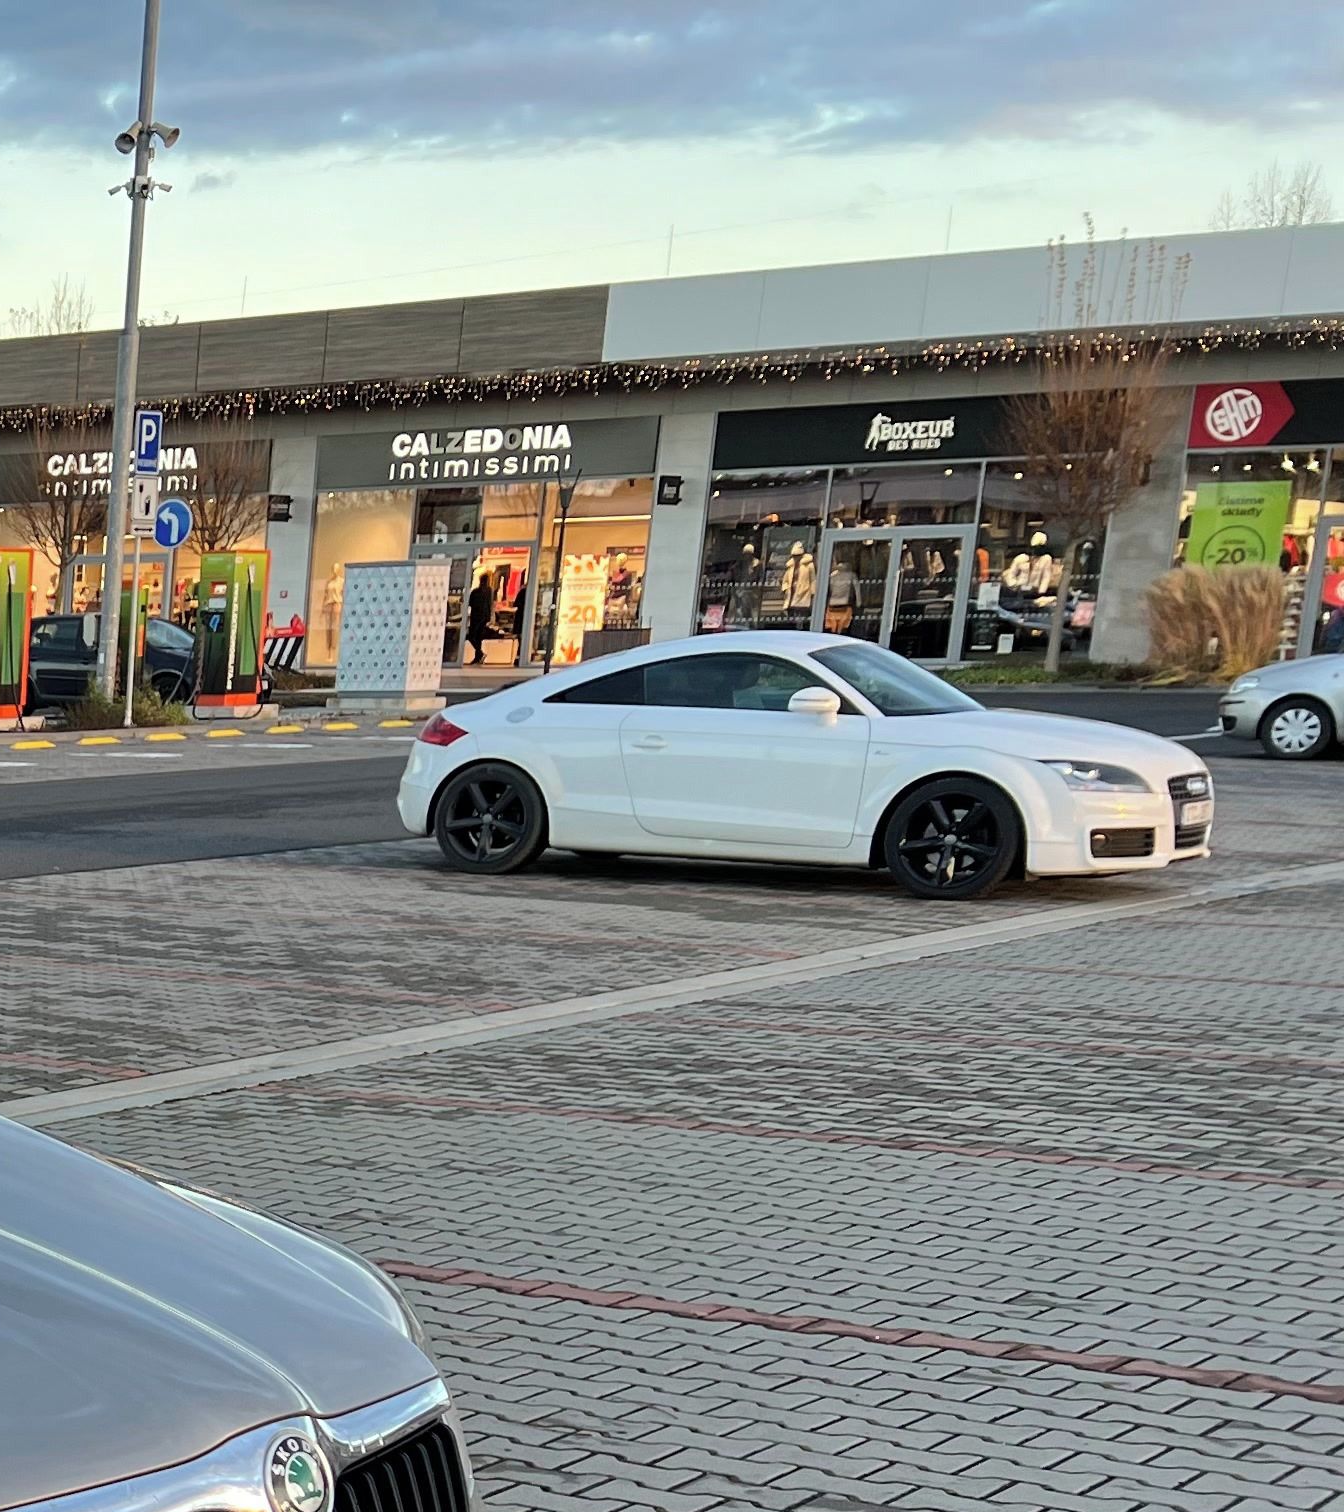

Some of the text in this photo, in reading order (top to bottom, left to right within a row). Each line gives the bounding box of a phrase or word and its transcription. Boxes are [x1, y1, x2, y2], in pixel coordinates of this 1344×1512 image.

[140, 418, 157, 455] P
[391, 424, 572, 458] CALZEDONIA
[879, 419, 954, 441] BOXEUR
[47, 447, 198, 477] CALZNIA
[388, 453, 571, 481] intimissimi
